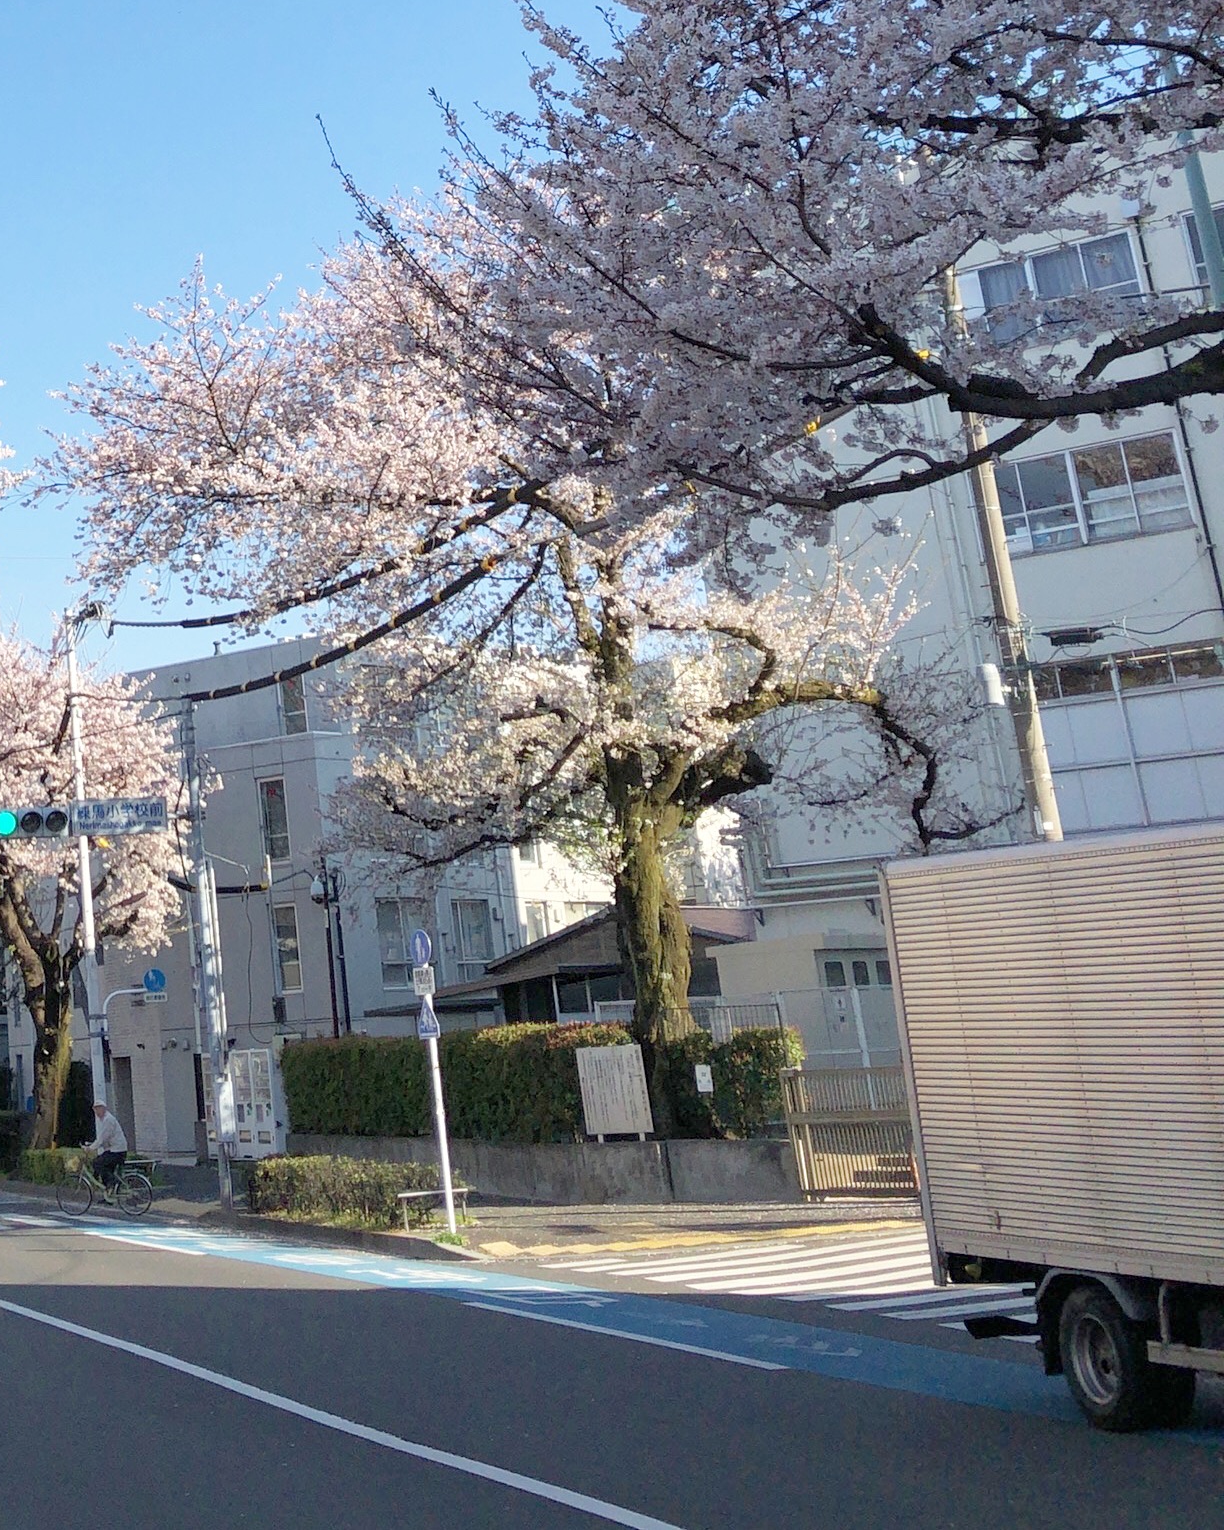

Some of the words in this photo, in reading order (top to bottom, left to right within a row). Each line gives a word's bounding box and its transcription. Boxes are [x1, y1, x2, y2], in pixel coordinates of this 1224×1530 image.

[78, 803, 163, 820] 練馬小学校前
